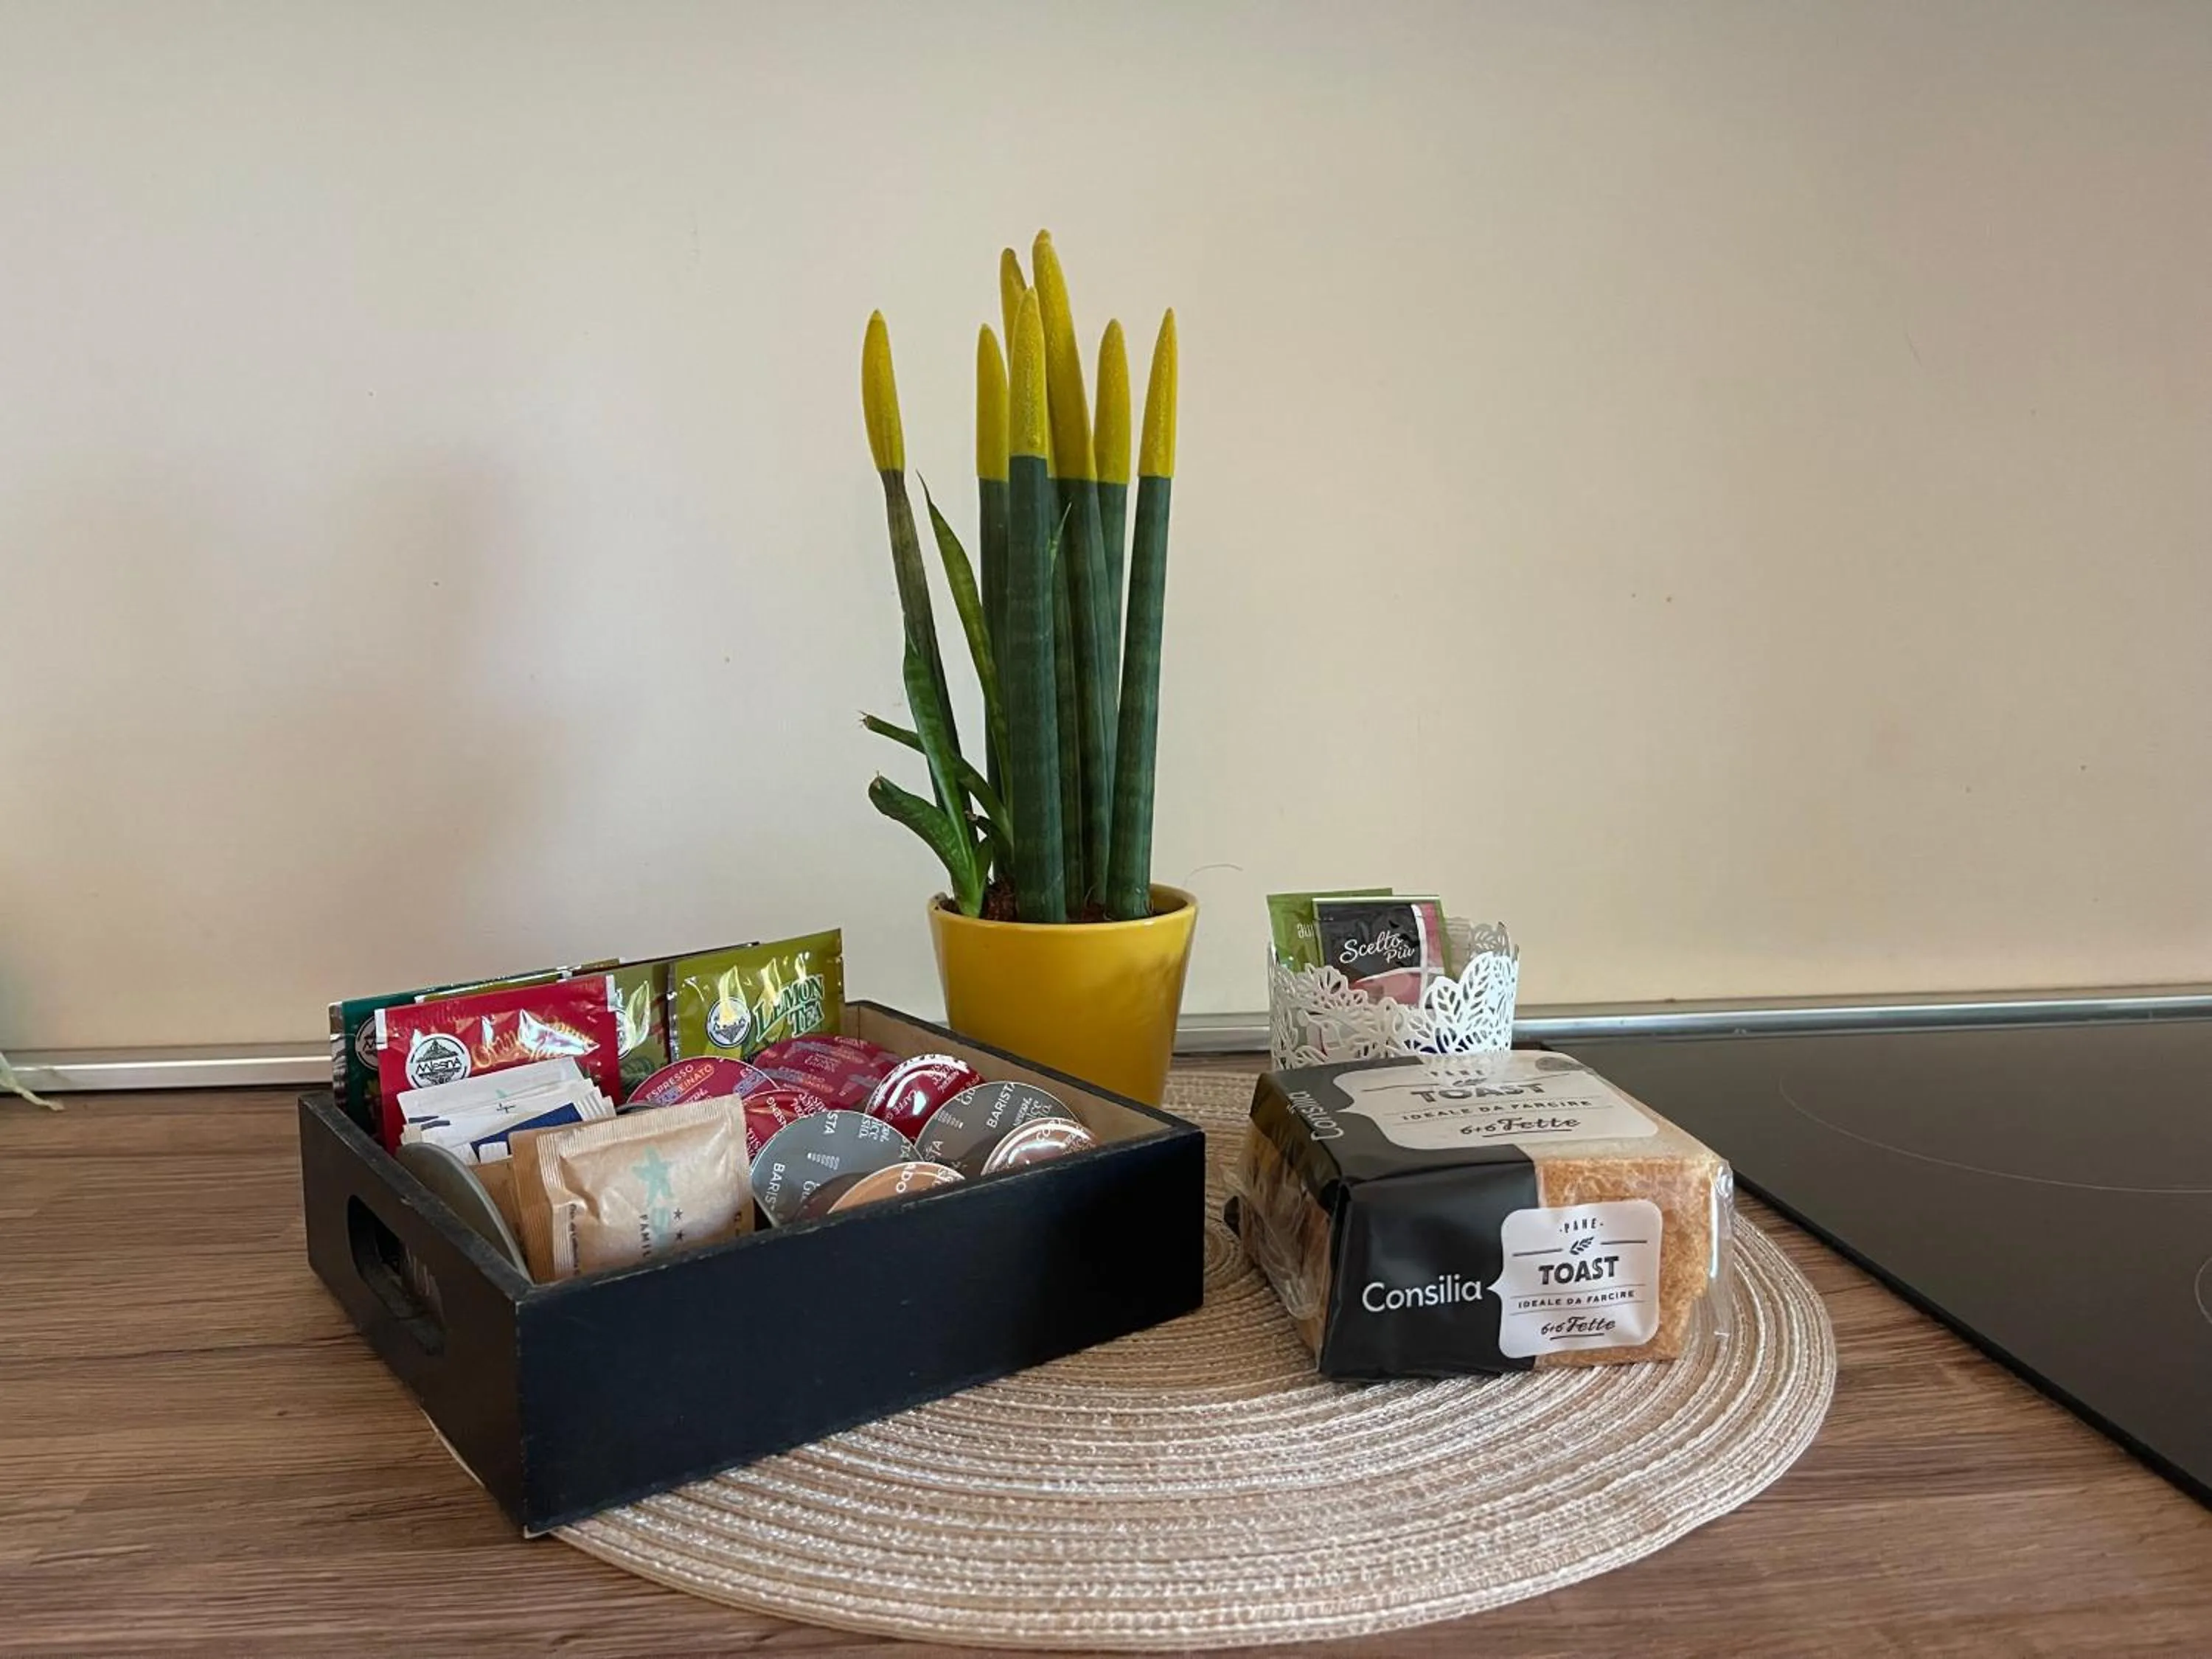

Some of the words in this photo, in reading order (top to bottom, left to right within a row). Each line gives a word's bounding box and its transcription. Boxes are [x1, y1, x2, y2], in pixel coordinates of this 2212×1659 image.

[1340, 930, 1402, 964] Scelto
[753, 975, 825, 1042] LEMON
[787, 1001, 825, 1038] TEA
[645, 1064, 694, 1101] ESPRESSO
[1410, 1083, 1545, 1103] TOAST
[1402, 1108, 1472, 1120] IDEALE
[1538, 1256, 1619, 1285] TOAST
[1362, 1274, 1483, 1312] Consilia
[1518, 1298, 1562, 1309] IDEALE
[1587, 1290, 1635, 1303] FARCIRE
